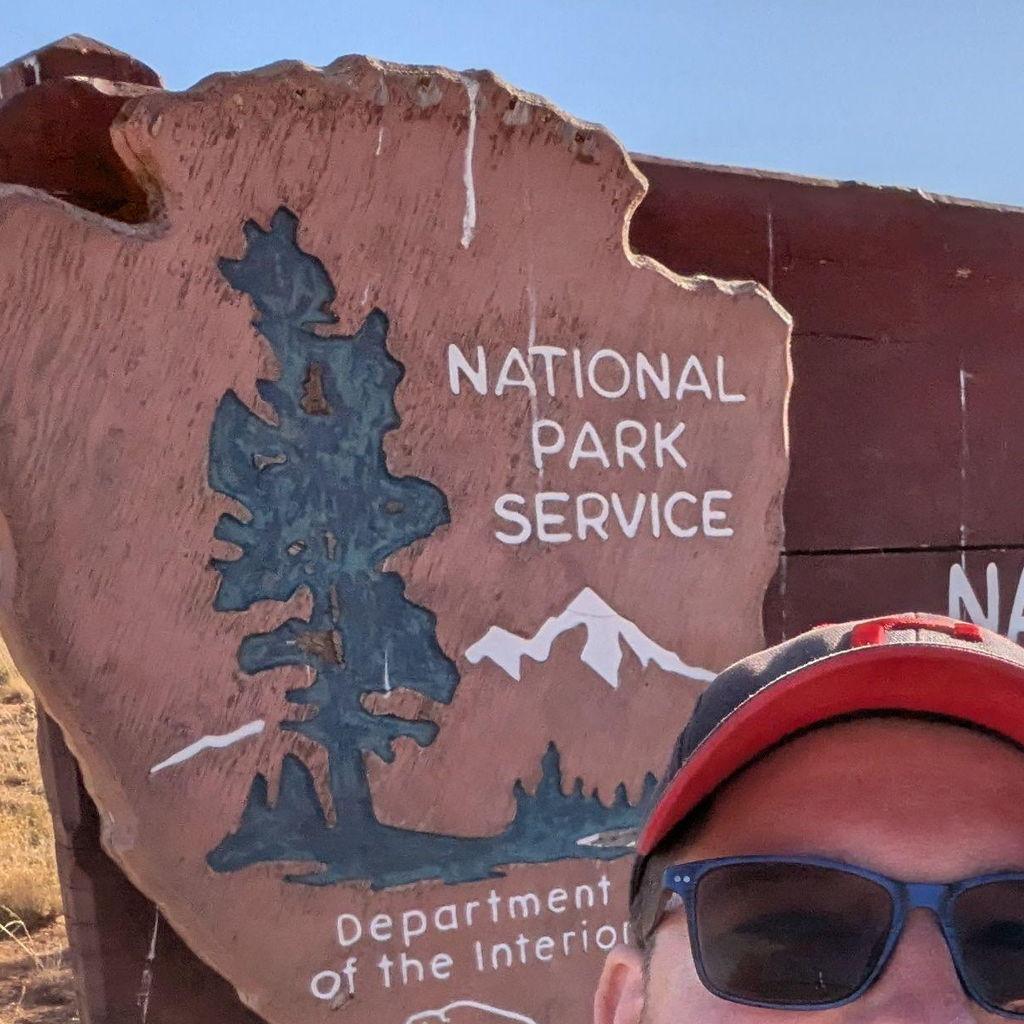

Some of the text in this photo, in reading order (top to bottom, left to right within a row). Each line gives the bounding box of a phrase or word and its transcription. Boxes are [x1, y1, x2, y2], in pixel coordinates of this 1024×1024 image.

[448, 343, 746, 402] NATIONAL
[531, 419, 687, 470] PARK
[494, 490, 734, 544] SERVICE
[337, 875, 611, 947] Department
[310, 957, 357, 1000] of
[378, 952, 453, 988] the
